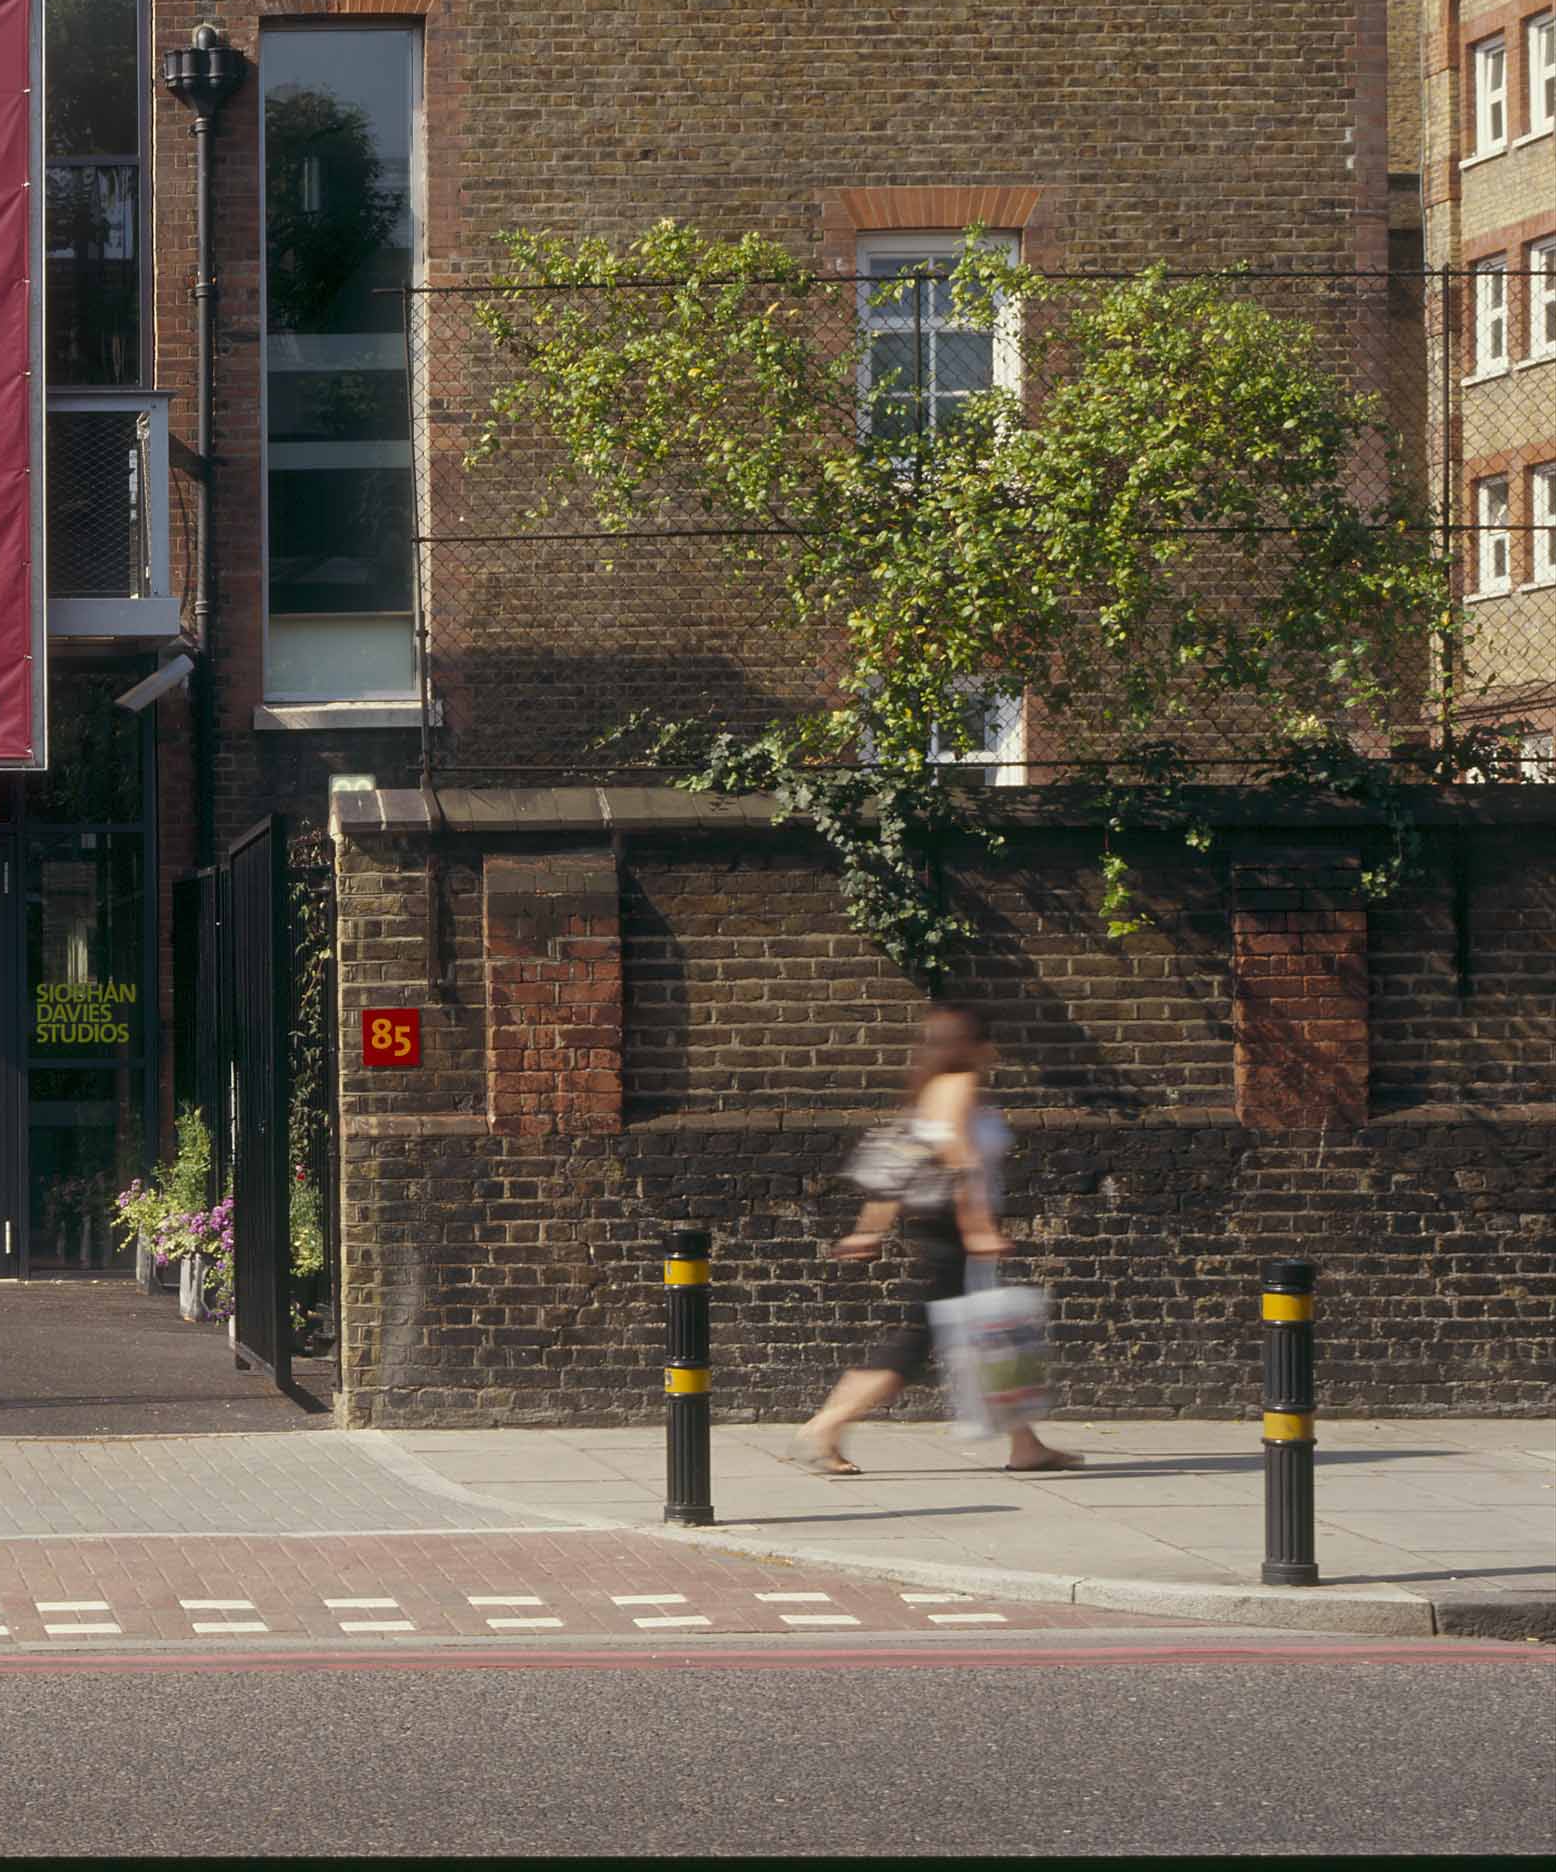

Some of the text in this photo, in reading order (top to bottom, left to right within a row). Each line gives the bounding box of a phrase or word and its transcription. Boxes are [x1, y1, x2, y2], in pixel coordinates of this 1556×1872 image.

[36, 983, 137, 1003] SIOBHAN
[36, 1003, 113, 1023] DAVIES
[36, 1023, 130, 1043] STUDIOS
[371, 1018, 412, 1057] 85
